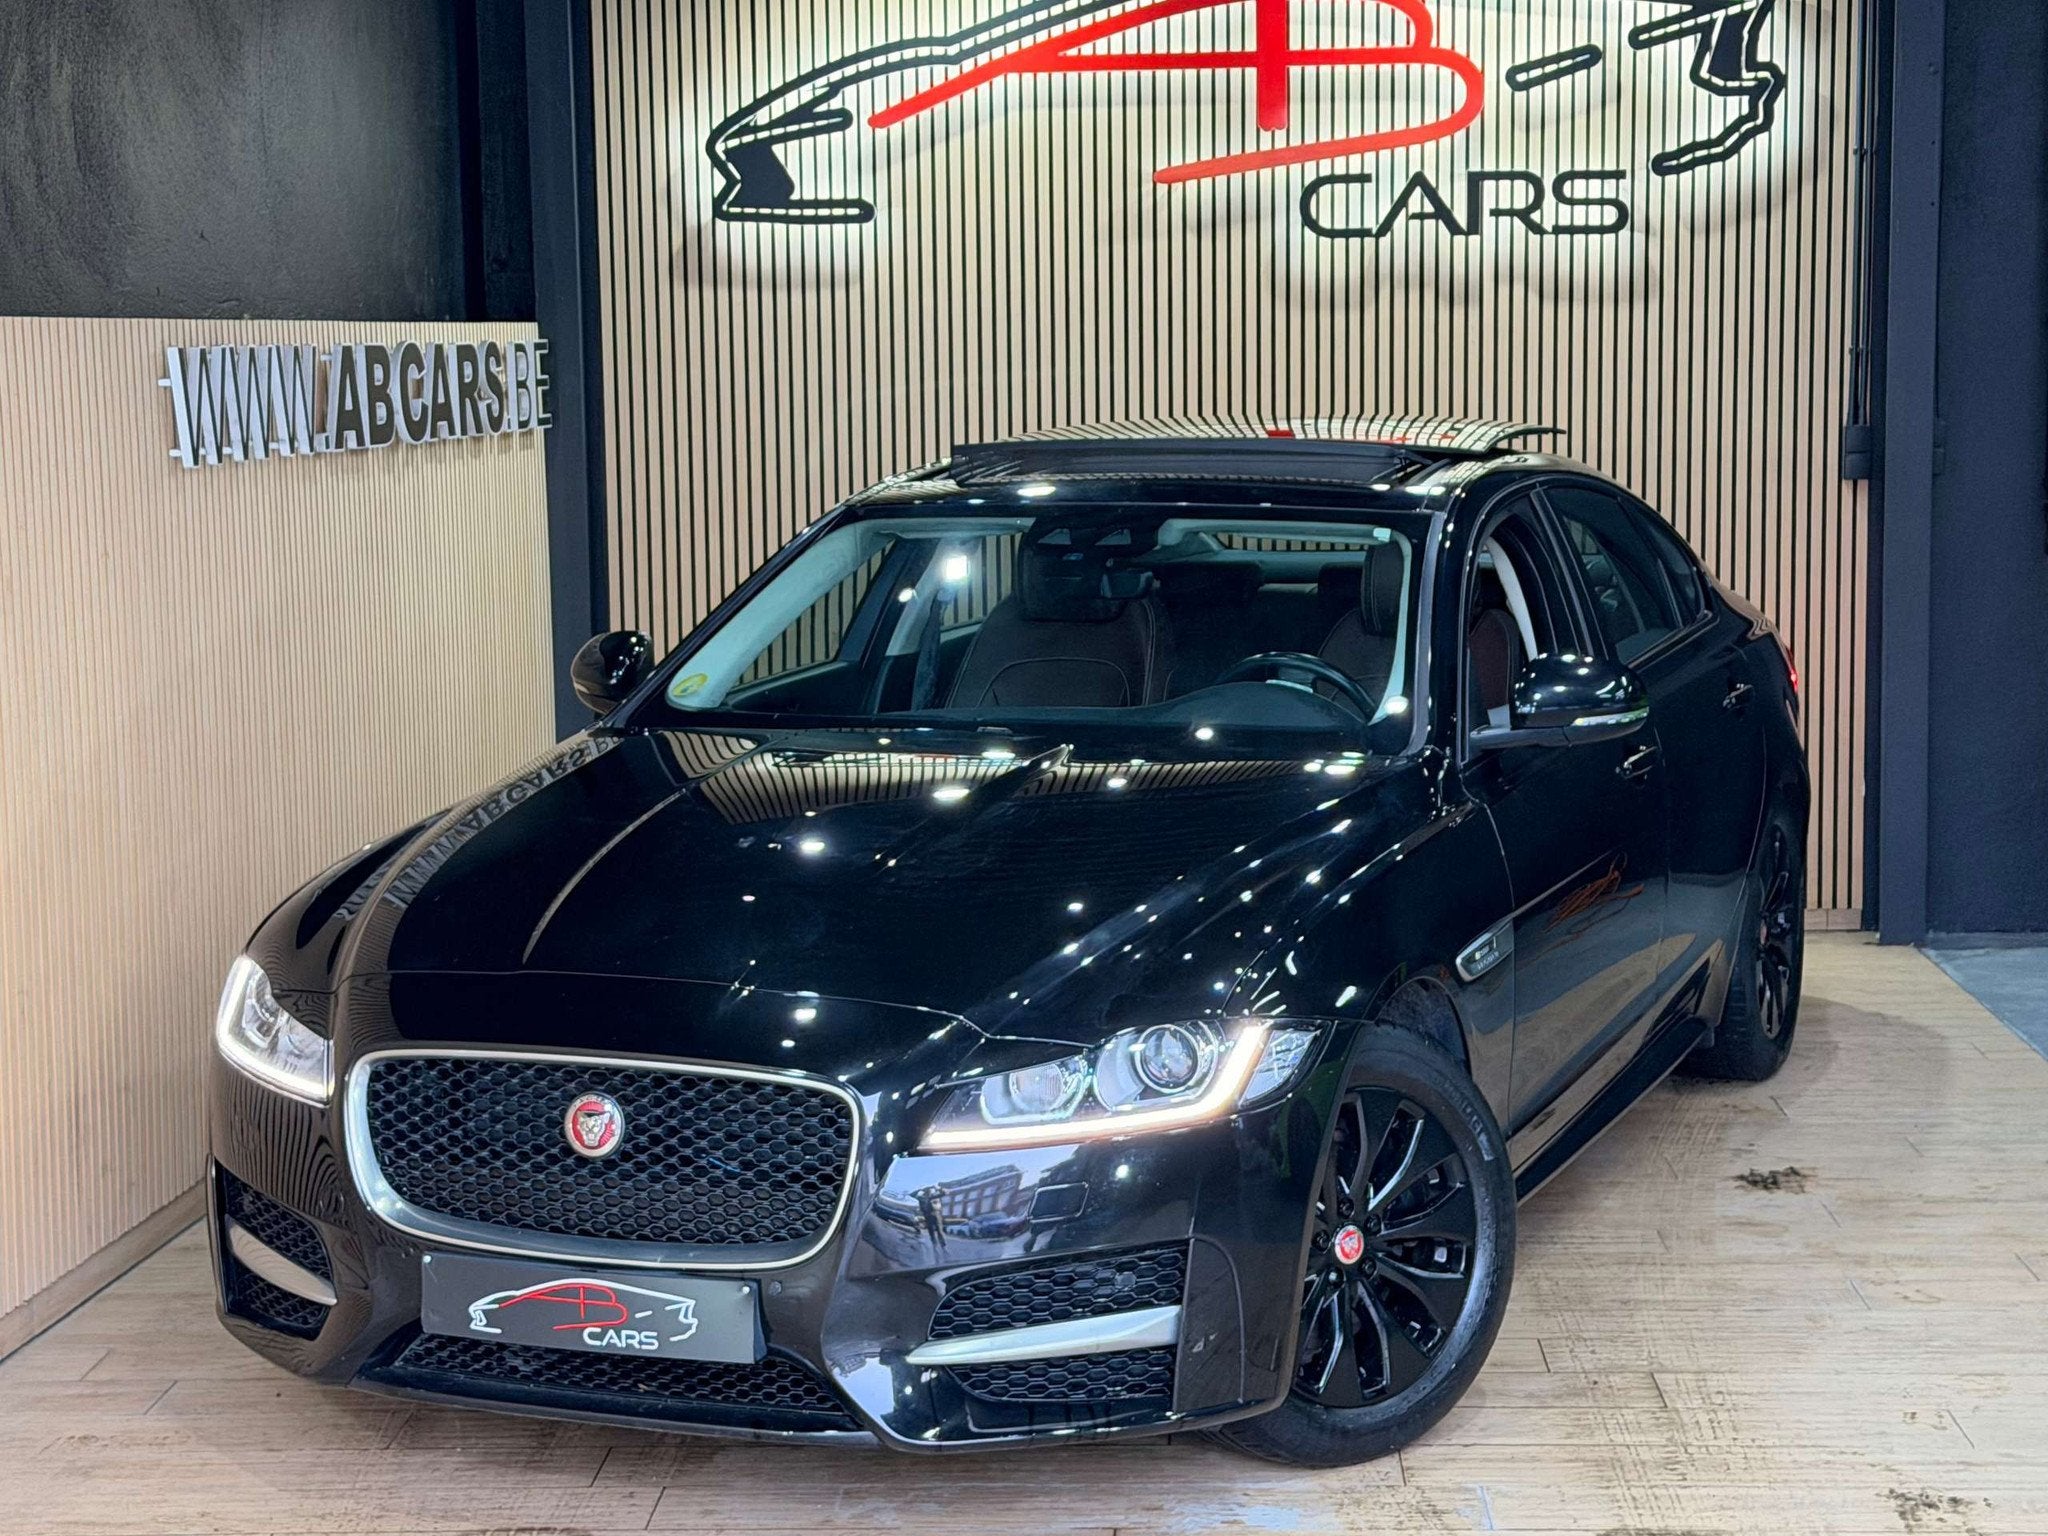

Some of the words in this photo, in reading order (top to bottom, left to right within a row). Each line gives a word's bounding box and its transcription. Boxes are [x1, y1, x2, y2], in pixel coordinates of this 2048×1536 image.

[1300, 170, 1629, 238] CARS
[167, 339, 553, 467] WWW.ABCARS.BE
[583, 1327, 659, 1350] CARS
